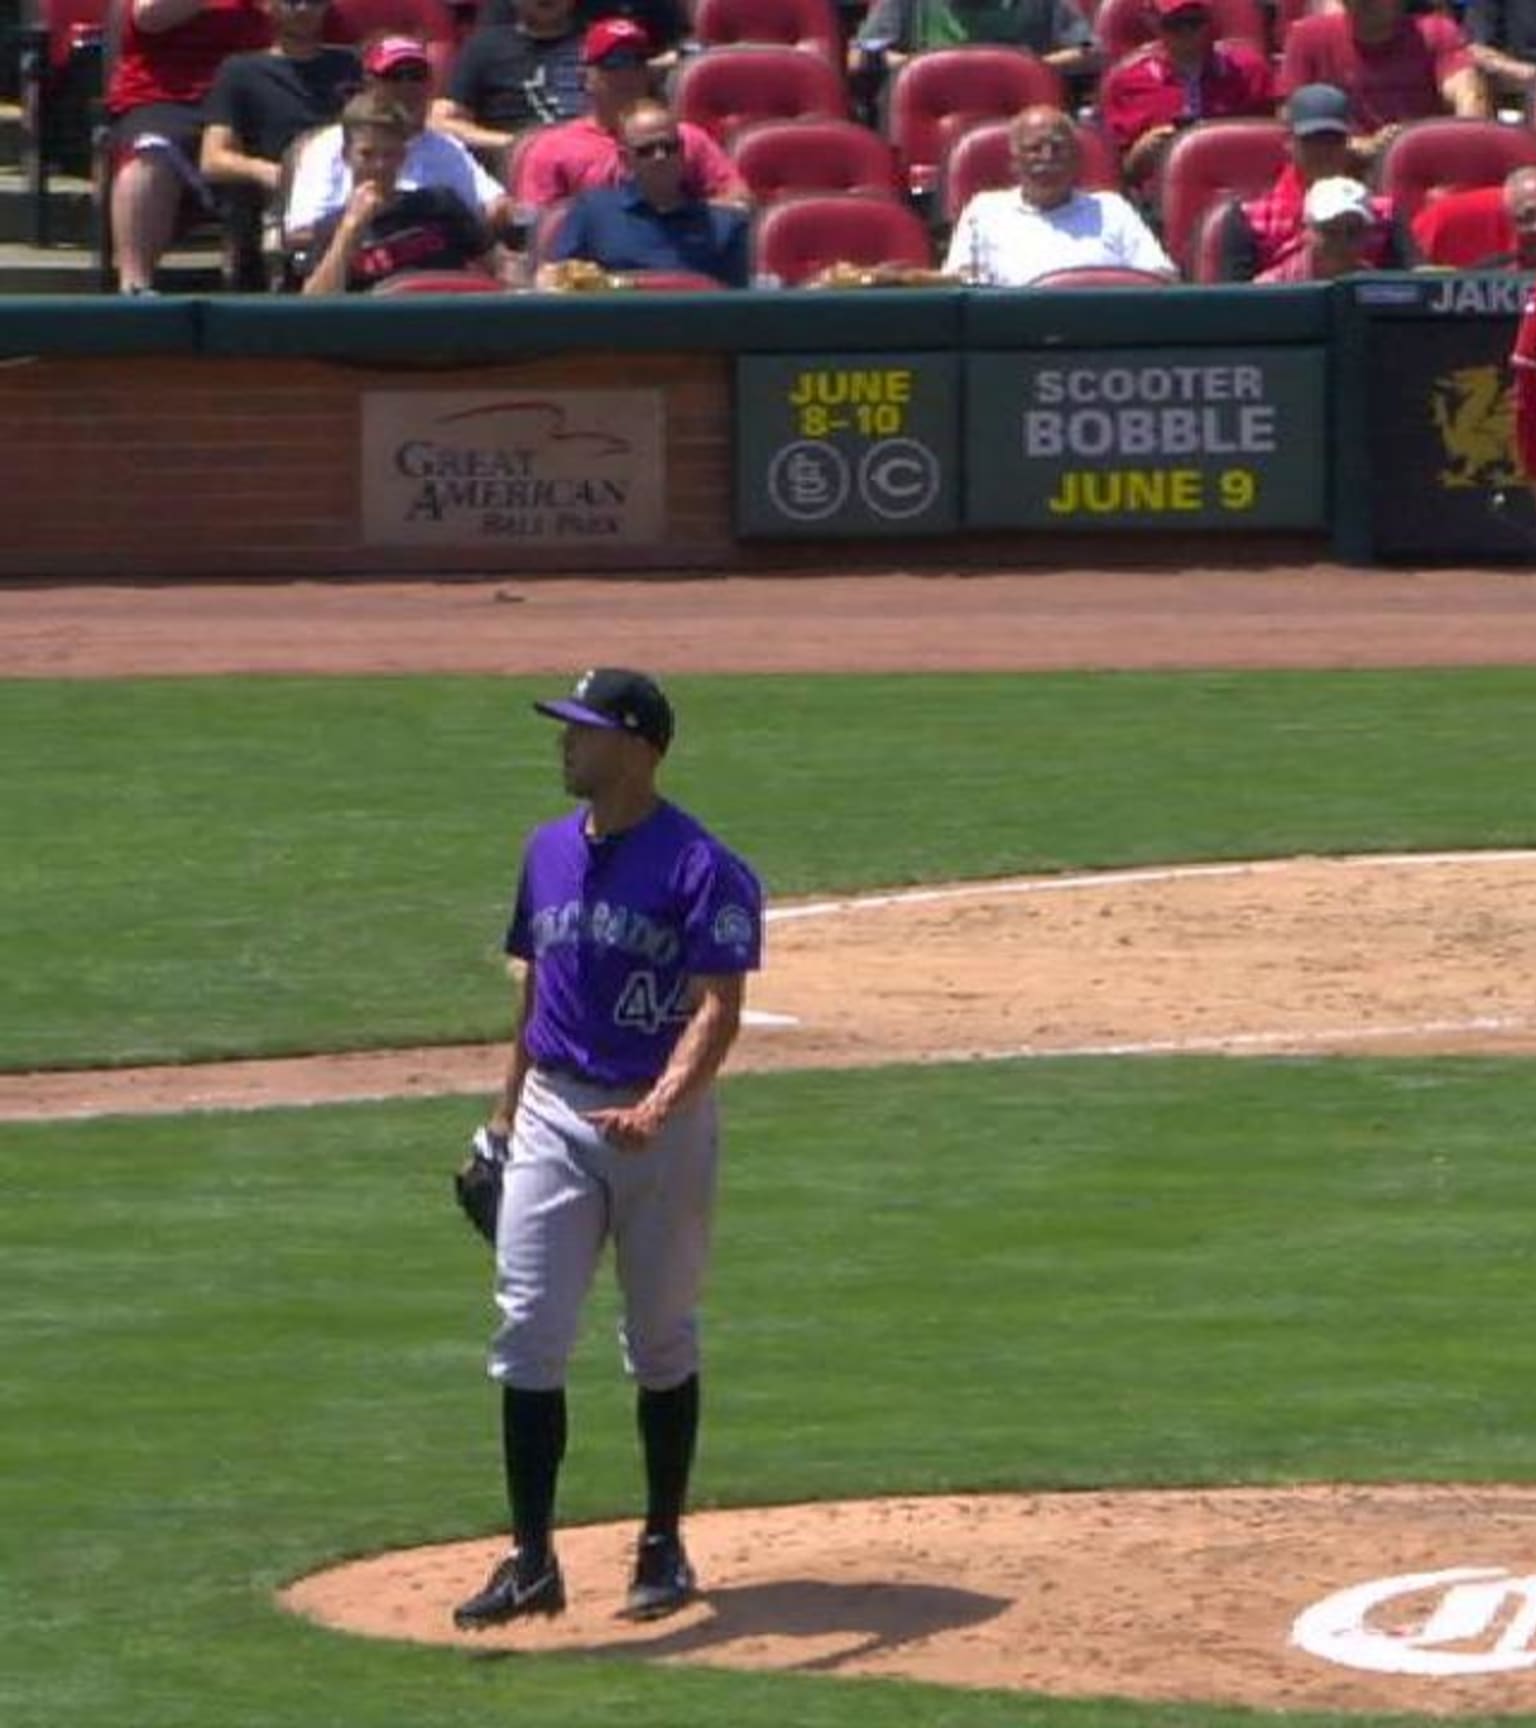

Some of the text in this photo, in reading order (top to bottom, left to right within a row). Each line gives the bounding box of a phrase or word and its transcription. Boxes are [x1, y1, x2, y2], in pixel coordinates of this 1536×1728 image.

[789, 369, 911, 405] JUNE
[1034, 365, 1263, 403] SCOOTER
[802, 404, 902, 438] 8-10
[1023, 404, 1277, 457] BOBBLE
[395, 440, 536, 479] GREAT
[1049, 468, 1257, 514] JUNE 9
